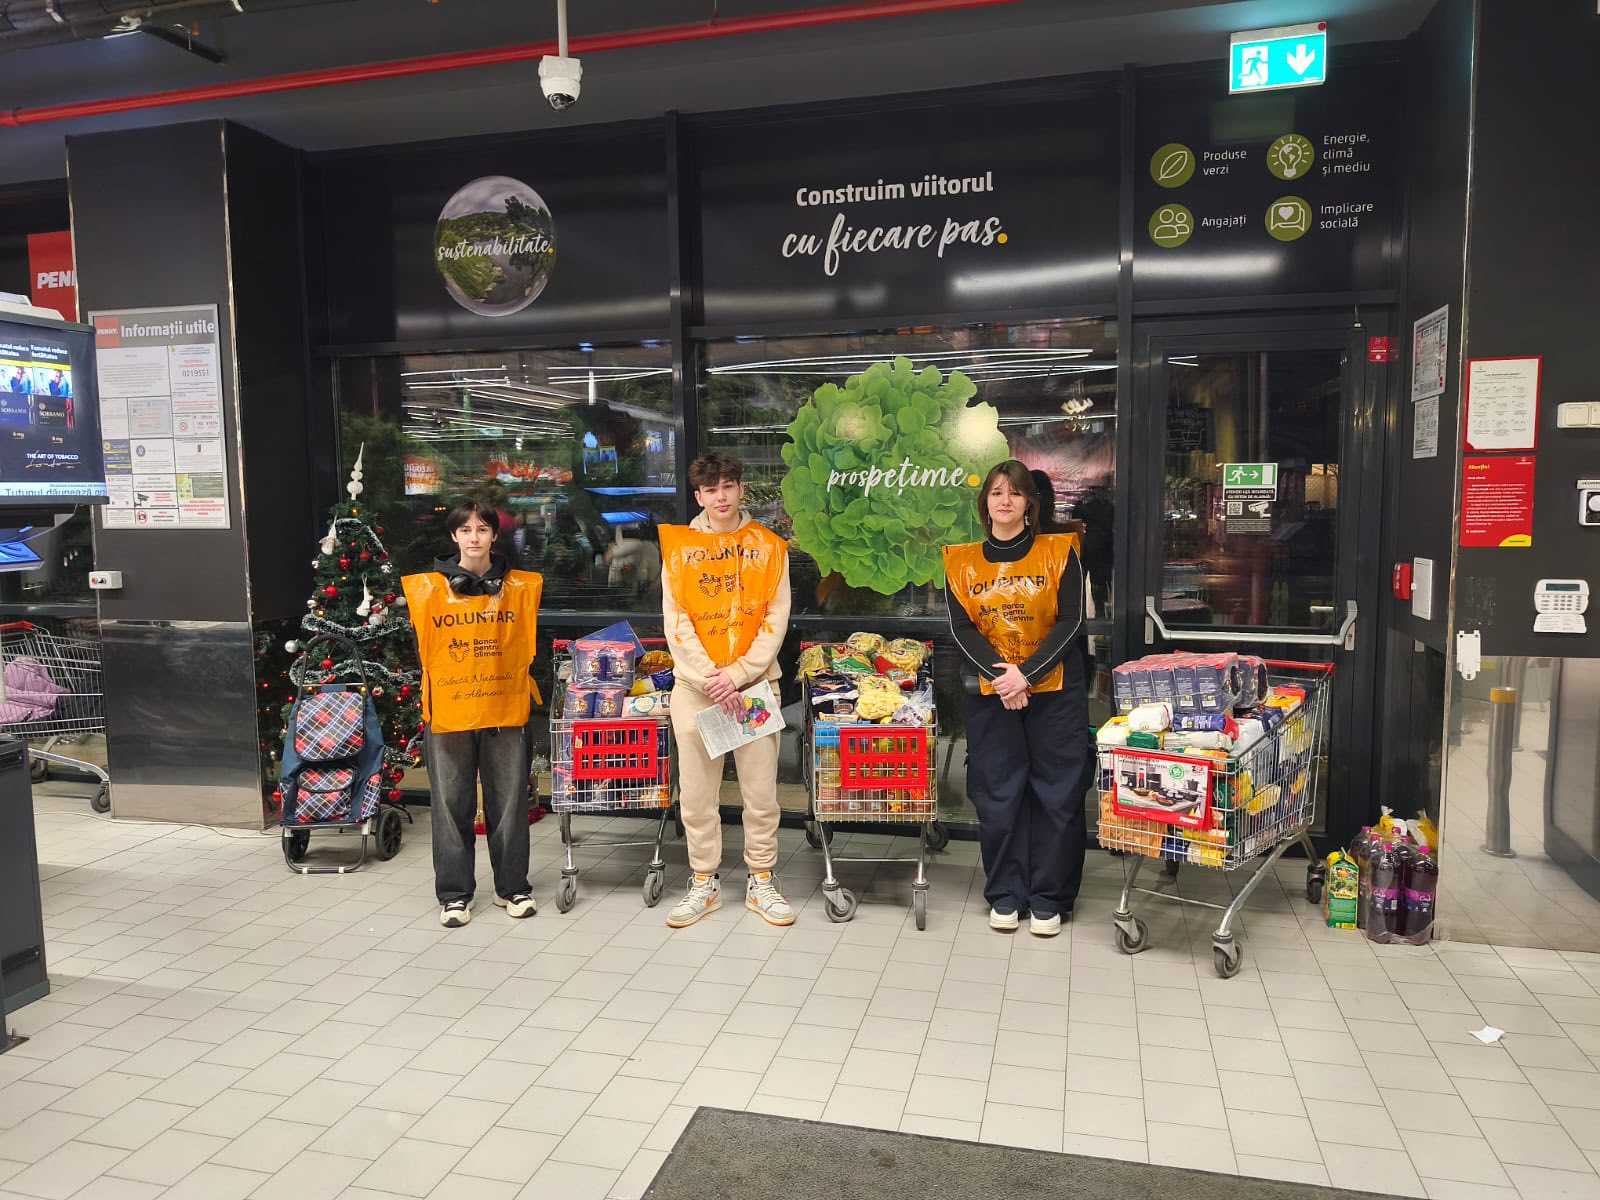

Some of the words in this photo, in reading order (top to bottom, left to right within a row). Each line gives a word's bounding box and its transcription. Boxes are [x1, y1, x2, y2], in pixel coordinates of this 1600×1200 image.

[1323, 132, 1370, 145] Energie,
[1203, 150, 1247, 161] Produse
[1322, 148, 1353, 160] climă
[1203, 165, 1230, 176] verzi
[1322, 165, 1332, 177] și
[1333, 162, 1371, 174] mediu
[796, 179, 905, 206] Construim
[910, 171, 994, 197] viitorul
[1320, 203, 1374, 216] Implicare
[1201, 215, 1247, 229] Angajați
[1320, 217, 1358, 230] socială
[782, 232, 823, 258] cu
[824, 213, 938, 276] fiecare
[121, 321, 182, 339] Informații
[186, 320, 215, 334] utile
[432, 611, 515, 628] VOLUNTAR
